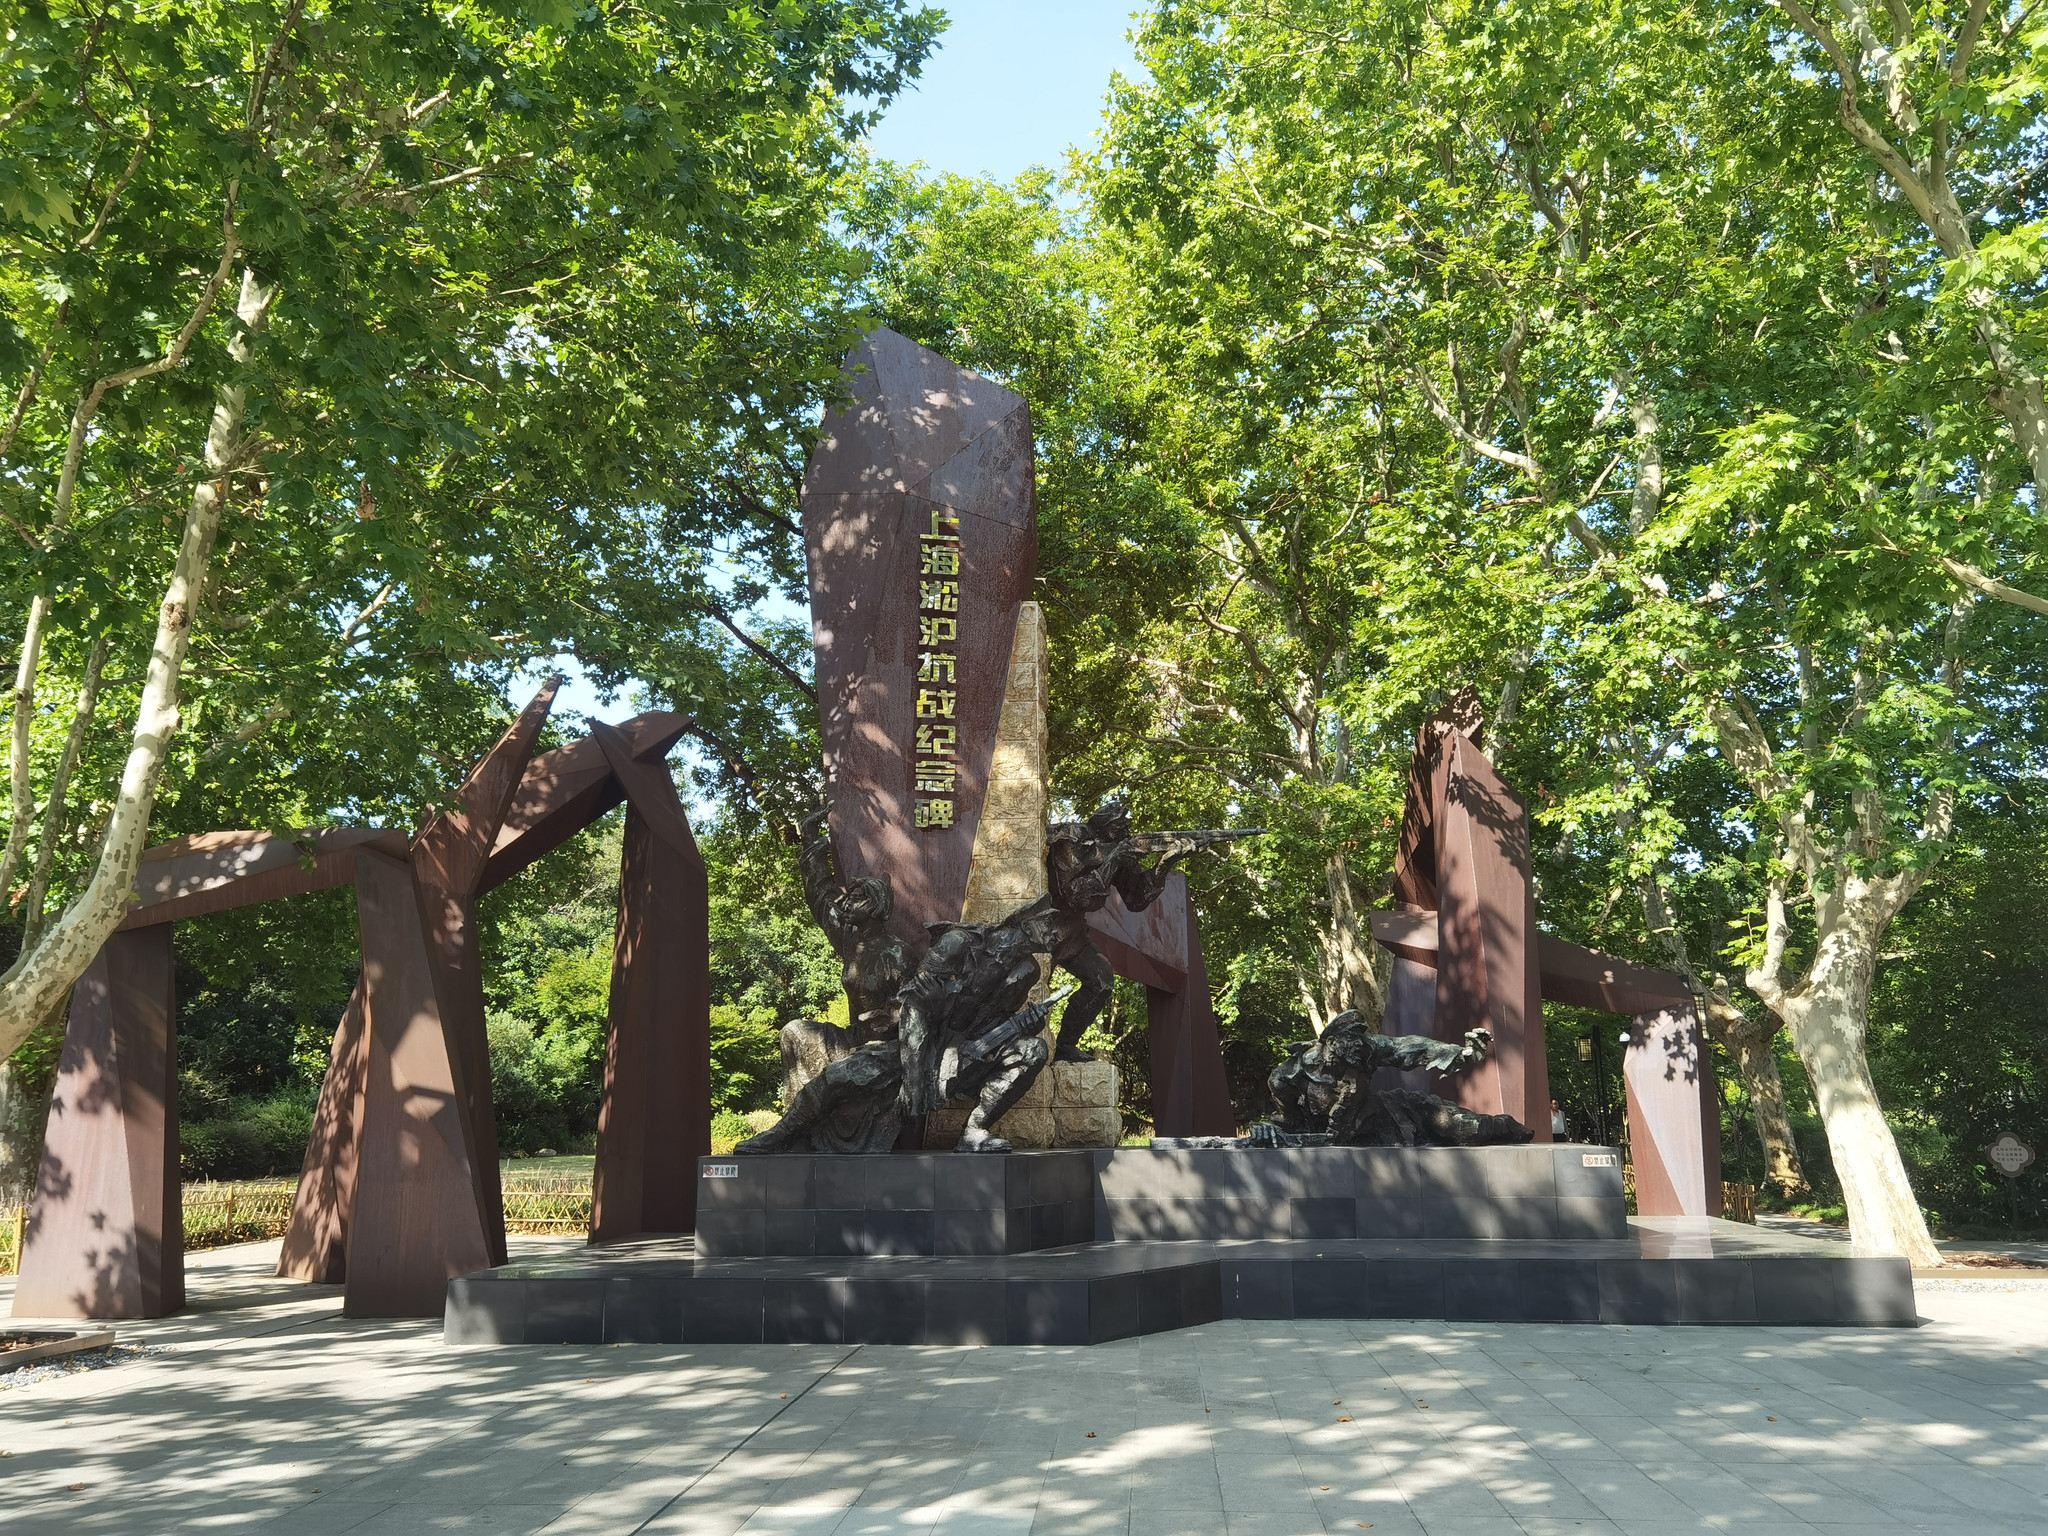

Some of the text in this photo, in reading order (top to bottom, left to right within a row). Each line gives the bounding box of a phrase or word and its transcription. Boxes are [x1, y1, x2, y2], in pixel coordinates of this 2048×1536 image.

[914, 510, 960, 828] 上海淞沪抗战纪念碑
